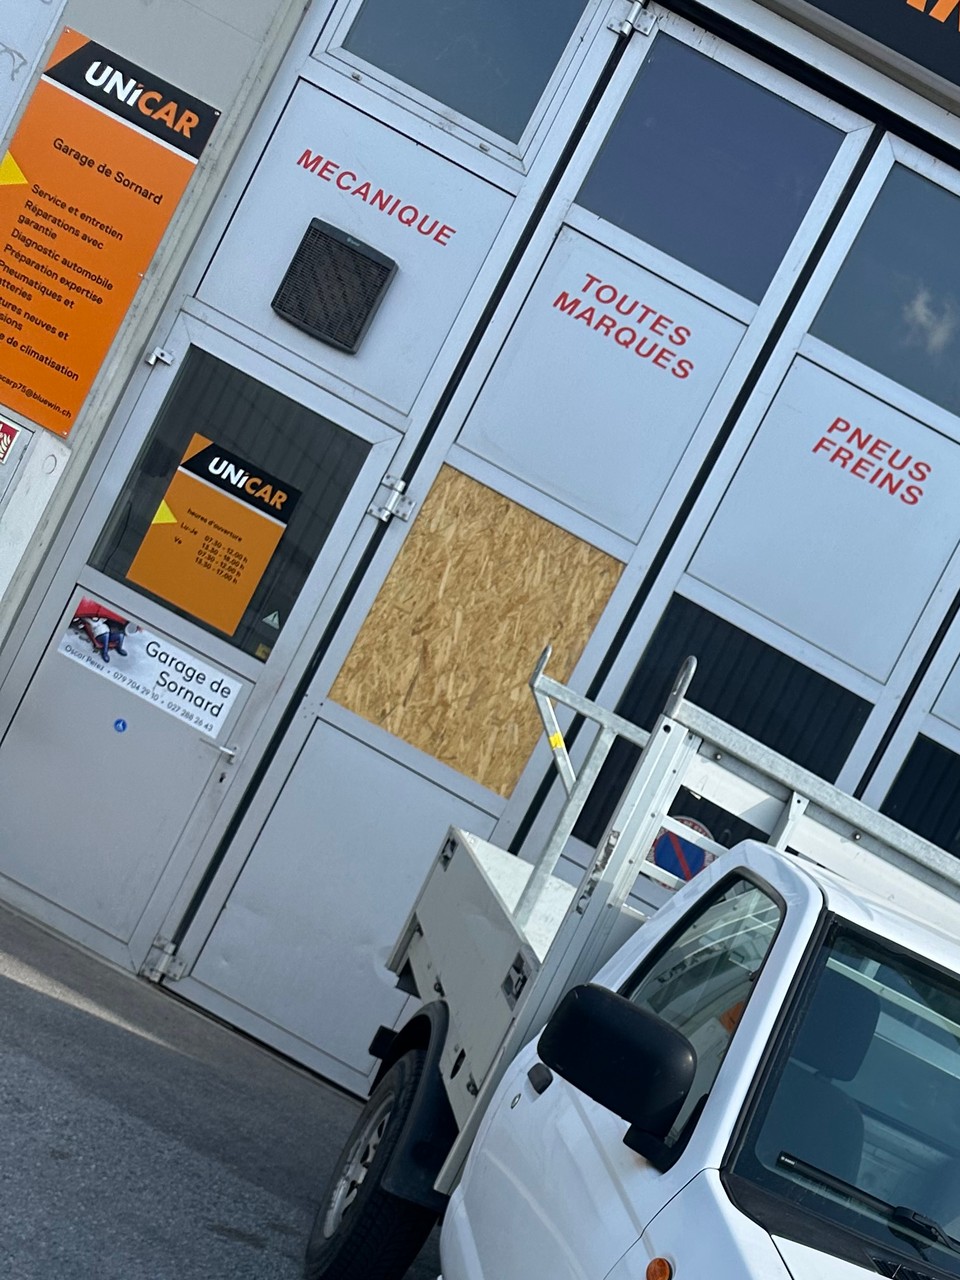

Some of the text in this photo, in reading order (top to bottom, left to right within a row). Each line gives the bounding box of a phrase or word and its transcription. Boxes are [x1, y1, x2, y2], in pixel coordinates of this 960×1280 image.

[53, 138, 164, 205] Garage de Sornard
[296, 148, 457, 247] MECANIQUE
[17, 215, 57, 240] garantie
[24, 200, 104, 250] Réparations avec
[31, 184, 124, 241] Service et entretien
[4, 243, 103, 305] Préparation expertise
[10, 227, 113, 291] Diagnostic automobile
[24, 312, 57, 334] neuves
[58, 330, 70, 341] et
[63, 298, 75, 310] et
[581, 273, 691, 346] TOUTES
[6, 337, 79, 381] de climatisation
[552, 291, 695, 379] MARQUES
[812, 436, 924, 506] FREINS
[826, 417, 932, 482] PNEUS
[187, 507, 208, 523] heures
[145, 641, 231, 699] Garage de
[156, 671, 224, 718] Sornard
